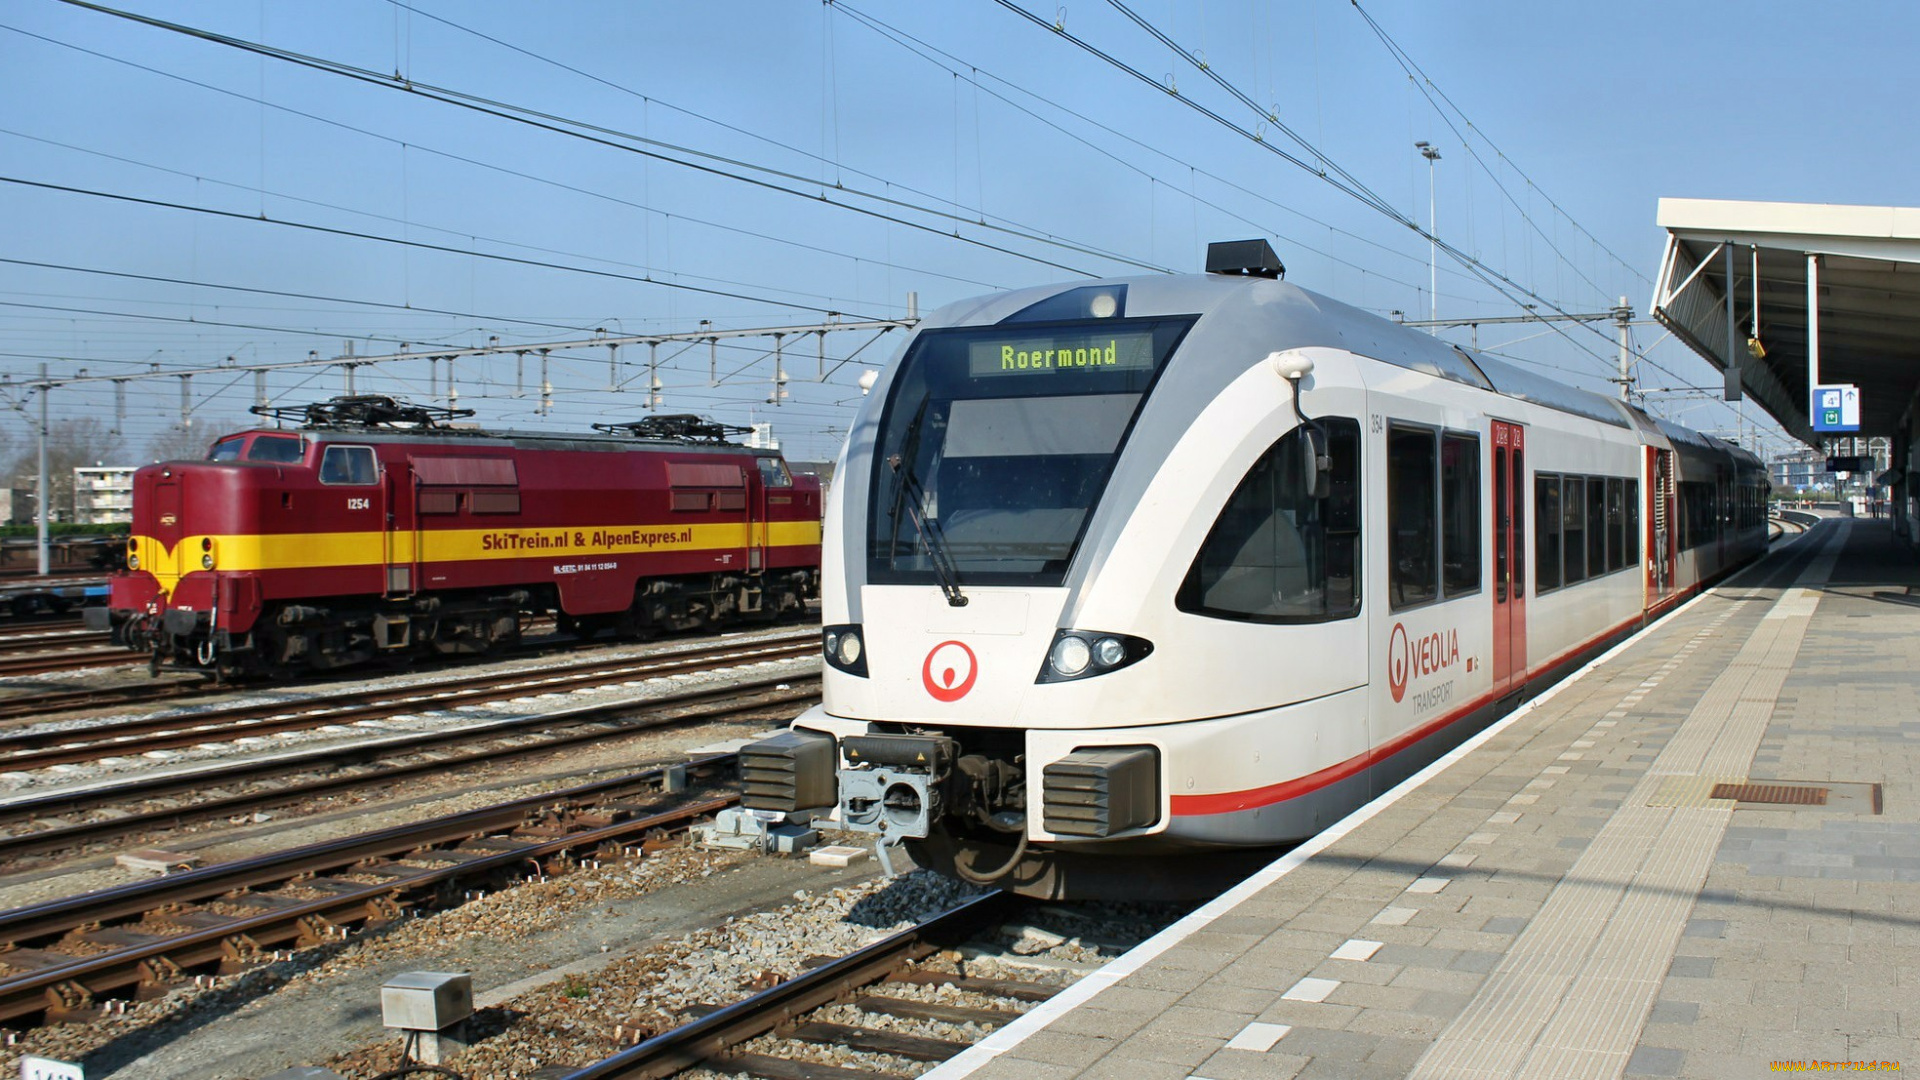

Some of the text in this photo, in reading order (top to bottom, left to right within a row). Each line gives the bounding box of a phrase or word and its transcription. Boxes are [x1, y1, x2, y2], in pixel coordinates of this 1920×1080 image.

[1001, 340, 1116, 370] Roermond
[1371, 413, 1383, 434] 354
[347, 498, 370, 510] 1254
[482, 528, 692, 550] SkiTrein.nl & AlpenExpres.nl
[1410, 627, 1460, 679] VEOLIA
[1412, 680, 1454, 716] TRANSPORT
